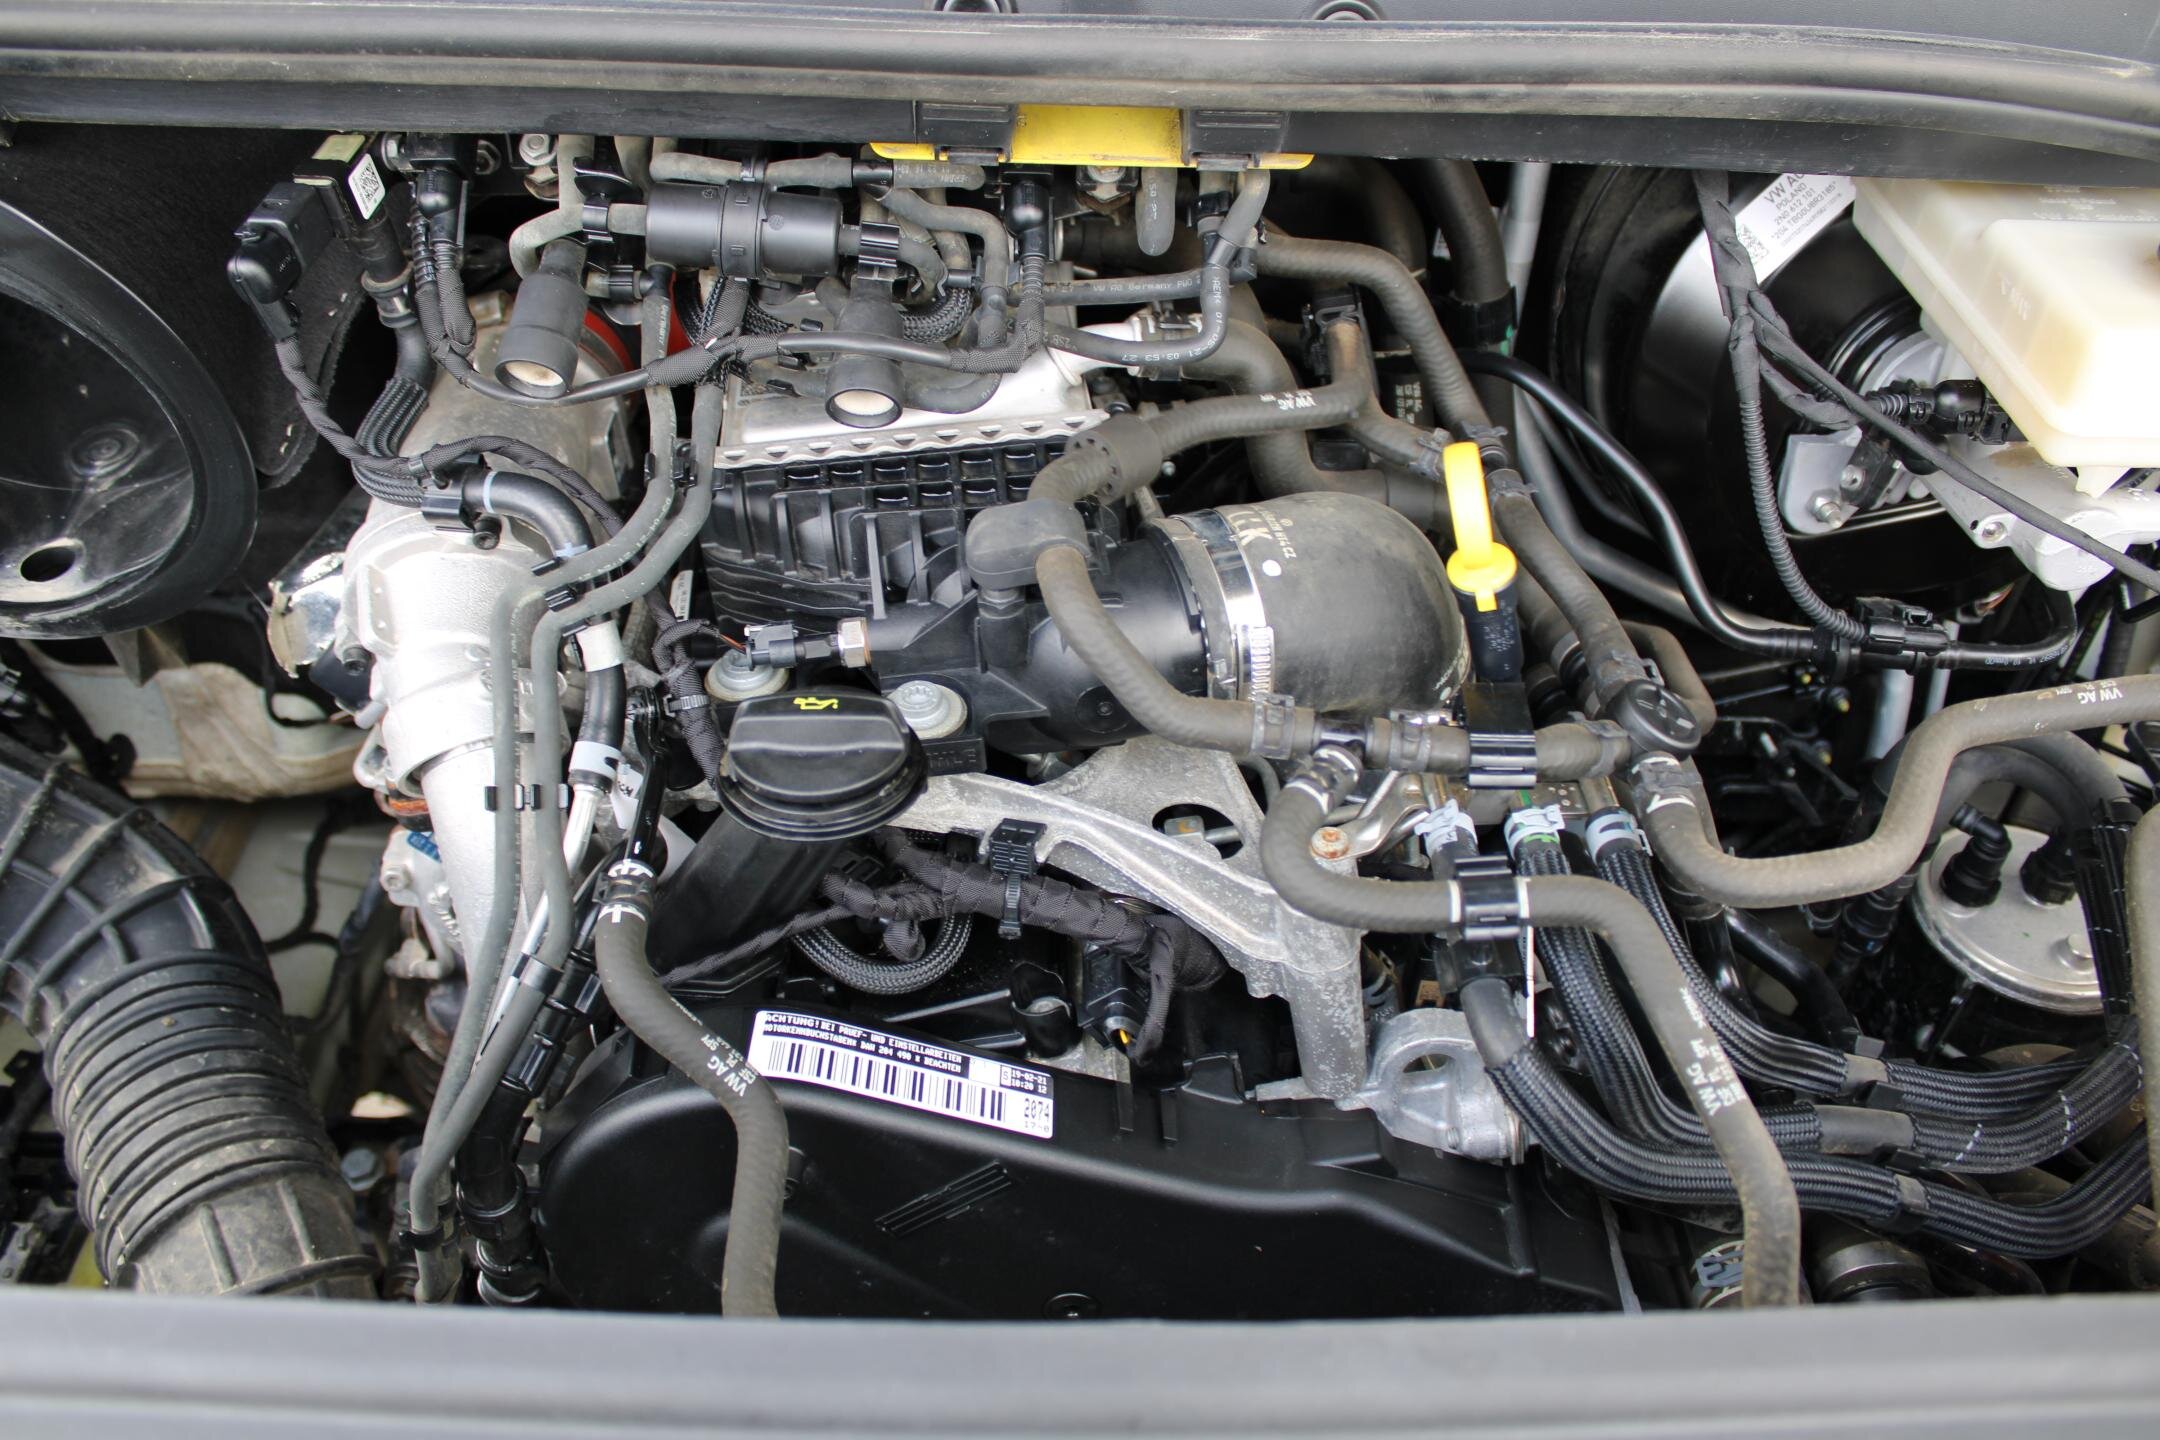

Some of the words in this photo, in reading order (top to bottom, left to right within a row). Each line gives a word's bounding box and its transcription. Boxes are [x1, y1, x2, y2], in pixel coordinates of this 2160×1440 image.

[1764, 182, 1787, 204] VW
[1775, 182, 1807, 211] POLAND
[2077, 690, 2097, 704] AG
[2099, 687, 2124, 702] VW
[700, 1034, 720, 1051] SPY
[706, 1055, 730, 1076] AG
[1686, 1062, 1709, 1085] AG
[724, 1072, 747, 1097] VW
[1011, 1068, 1047, 1085] 19-02-21
[1699, 1086, 1722, 1116] VW
